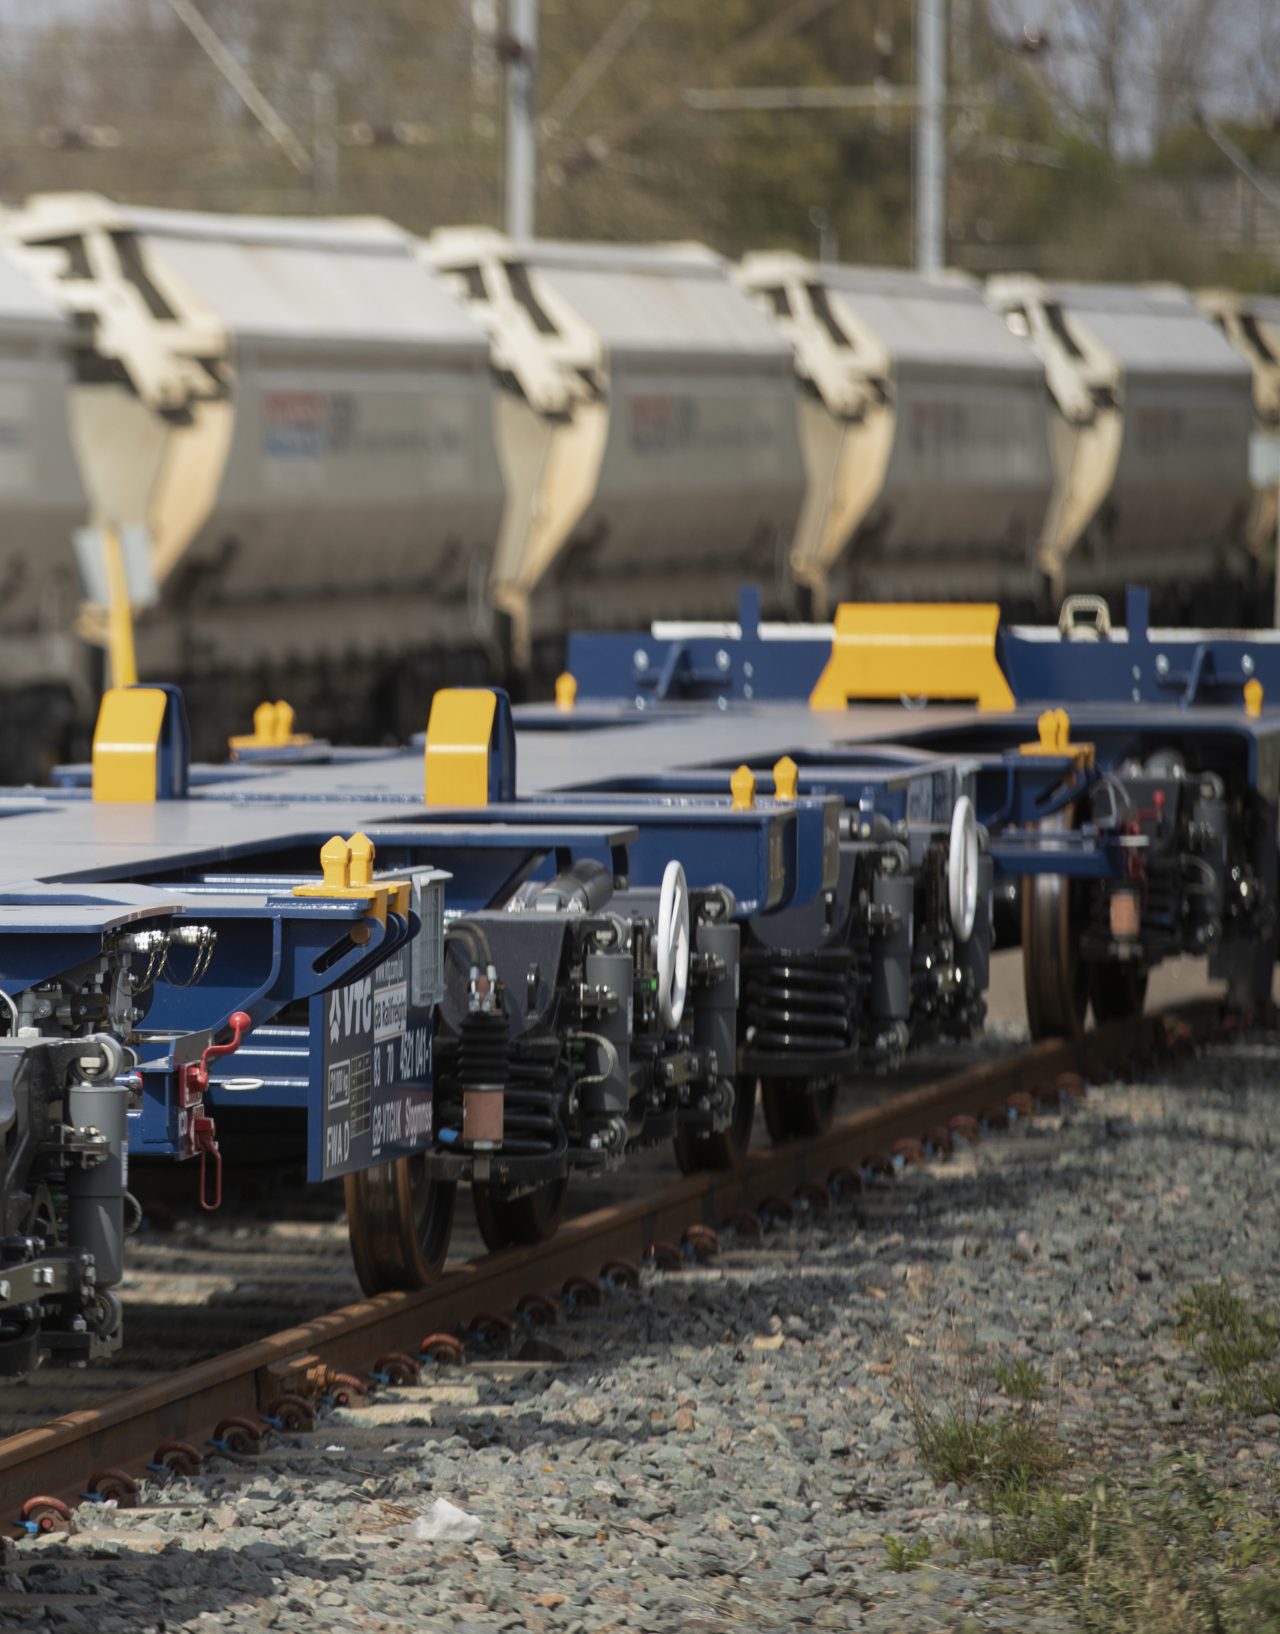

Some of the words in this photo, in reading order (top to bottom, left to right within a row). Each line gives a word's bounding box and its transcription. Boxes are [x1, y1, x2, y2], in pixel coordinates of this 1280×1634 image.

[343, 977, 372, 1037] VTG
[374, 1001, 382, 1030] GB
[382, 993, 406, 1031] Railfreight
[373, 1045, 381, 1087] 83
[387, 1043, 394, 1083] 70
[415, 1026, 433, 1078] 041-1
[326, 1121, 343, 1168] FWA
[344, 1120, 350, 1162] D
[372, 1099, 402, 1147] GB-VTGUK
